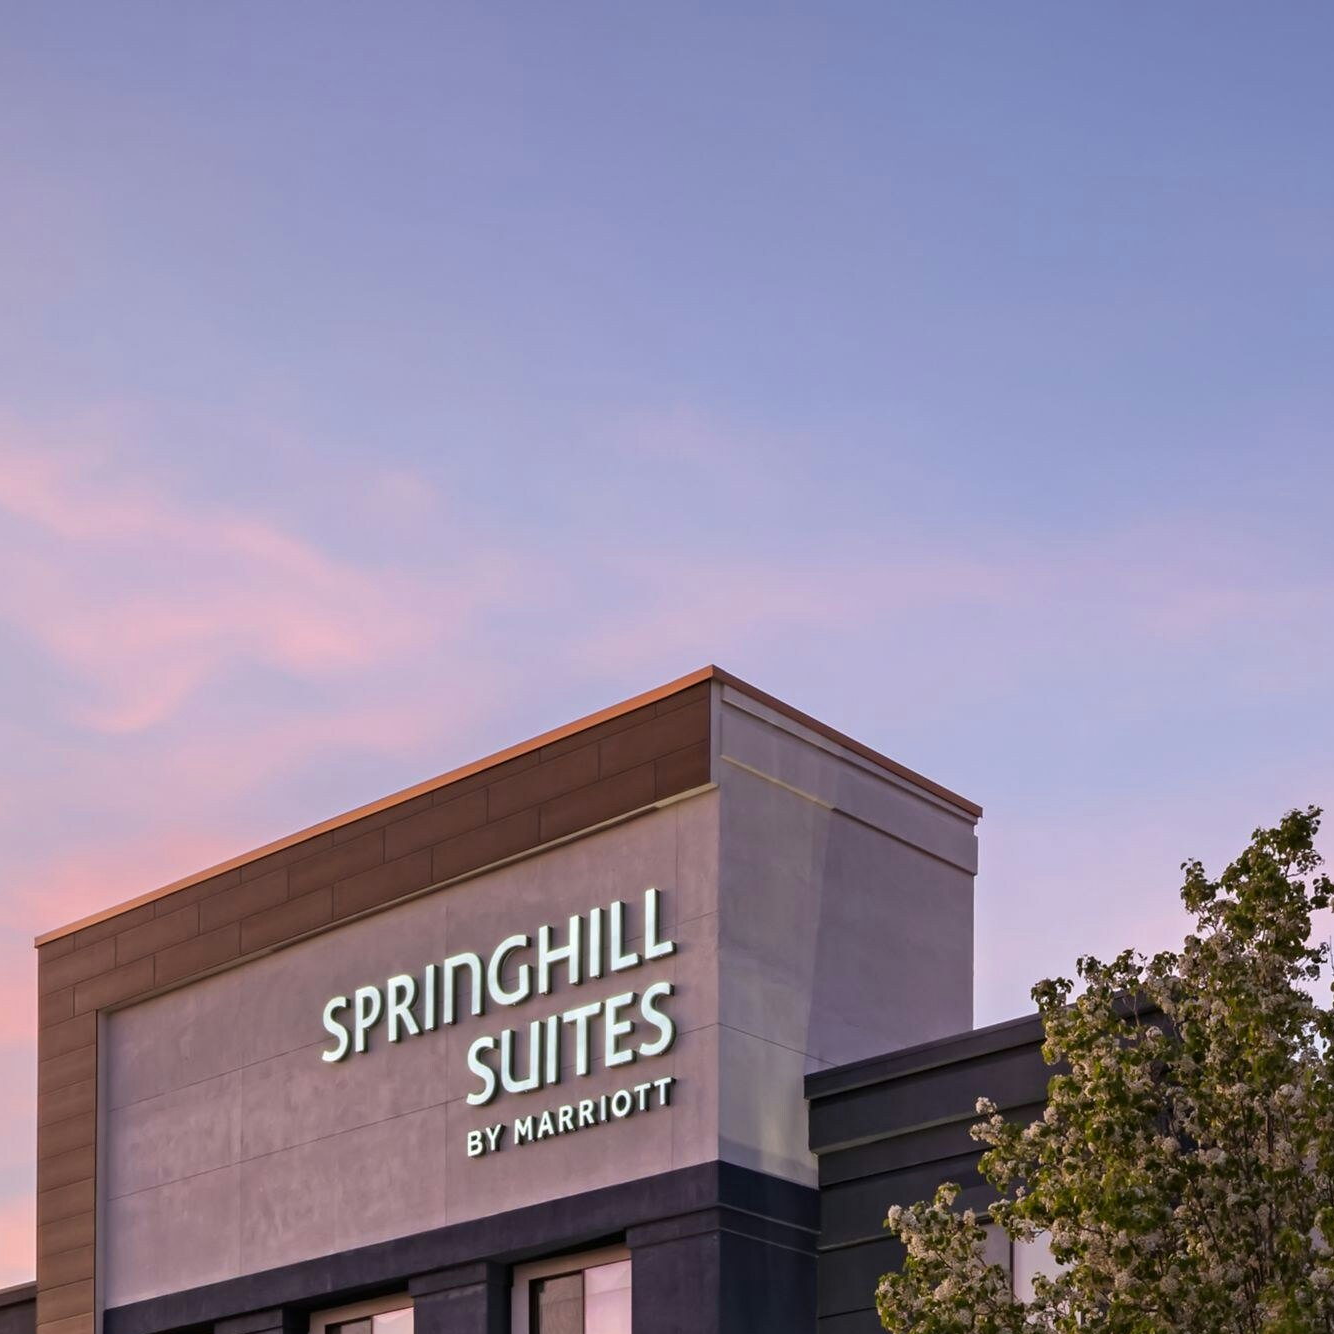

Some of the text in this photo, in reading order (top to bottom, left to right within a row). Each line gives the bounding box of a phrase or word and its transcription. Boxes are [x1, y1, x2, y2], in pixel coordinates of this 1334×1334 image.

[321, 887, 676, 1063] SPRINGHILL
[466, 981, 675, 1107] SUITES
[467, 1077, 676, 1158] BY MARRIOTT
